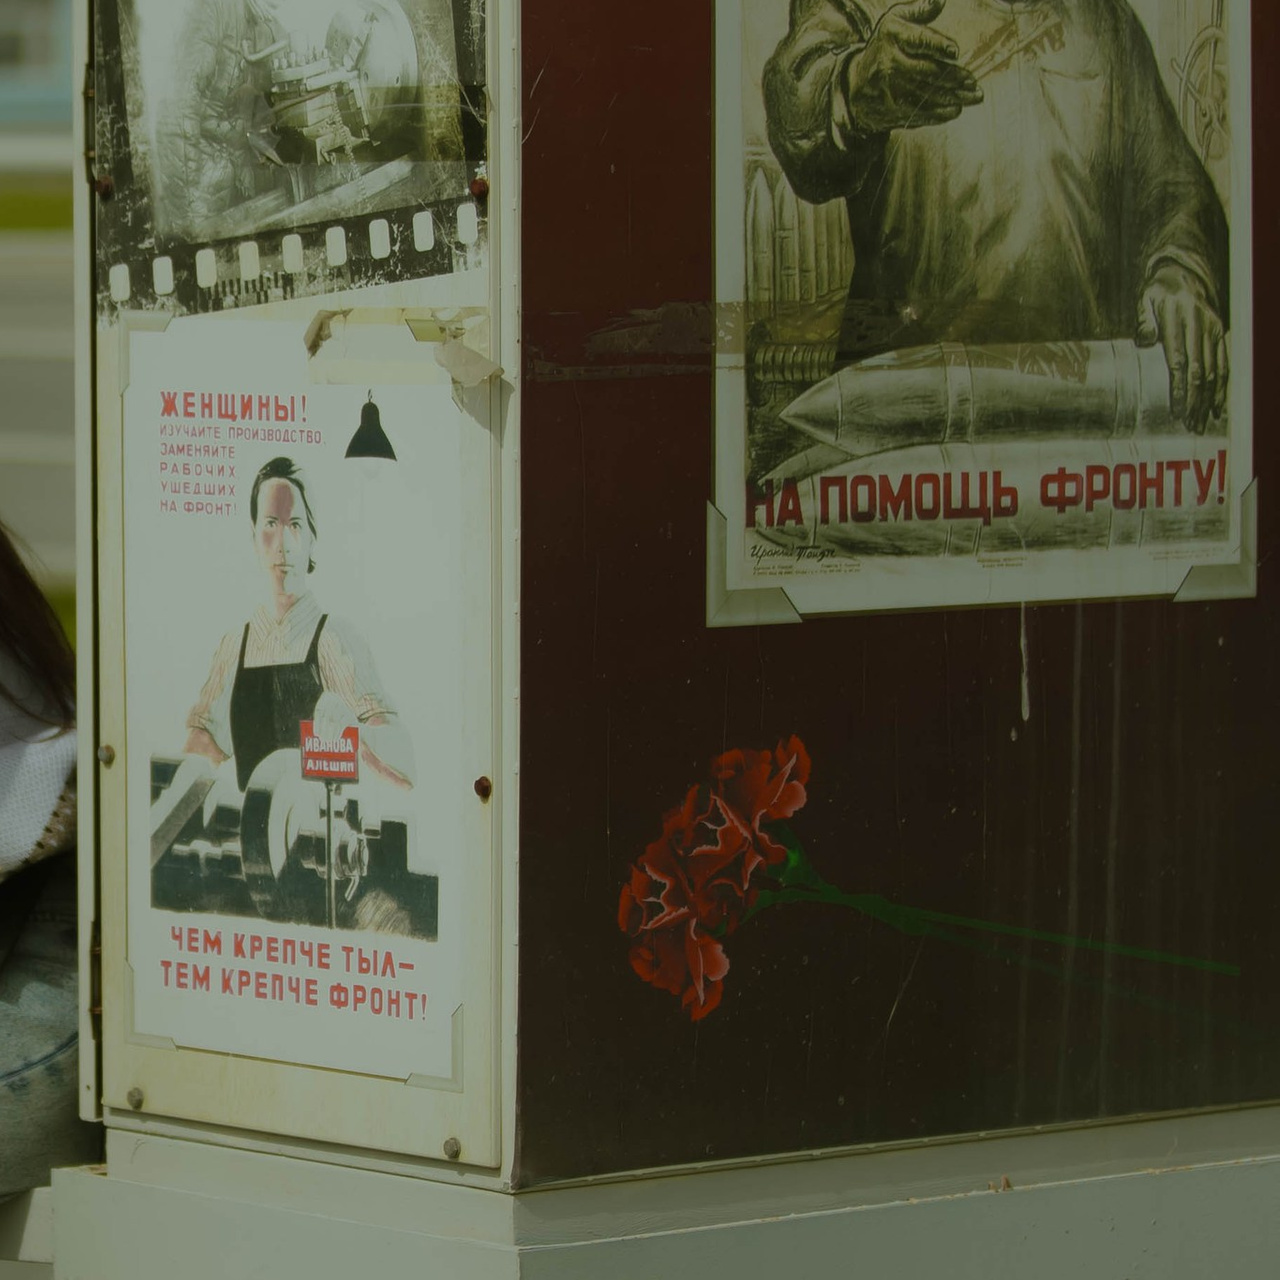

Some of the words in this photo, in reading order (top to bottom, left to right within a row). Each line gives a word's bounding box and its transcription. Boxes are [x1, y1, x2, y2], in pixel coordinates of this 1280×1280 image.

[160, 391, 307, 422] ЖЕНЩИНЫ!
[160, 462, 236, 478] РАБОЧИХ
[161, 481, 236, 497] УШЕДШИХ
[745, 477, 805, 529] НА
[820, 471, 1018, 526] ПОМОЩЬ
[1040, 450, 1227, 514] ФРОНТУ!
[160, 500, 177, 513] НА
[183, 501, 237, 516] ФРОНТ!
[305, 736, 354, 753] ИВАНОВА
[171, 926, 222, 955] ЧЕМ
[234, 933, 330, 970] КРЕПЧЕ
[160, 960, 210, 992] ТЕМ
[222, 968, 318, 1006] КРЕПЧЕ
[329, 982, 427, 1020] ФРОНТ!
